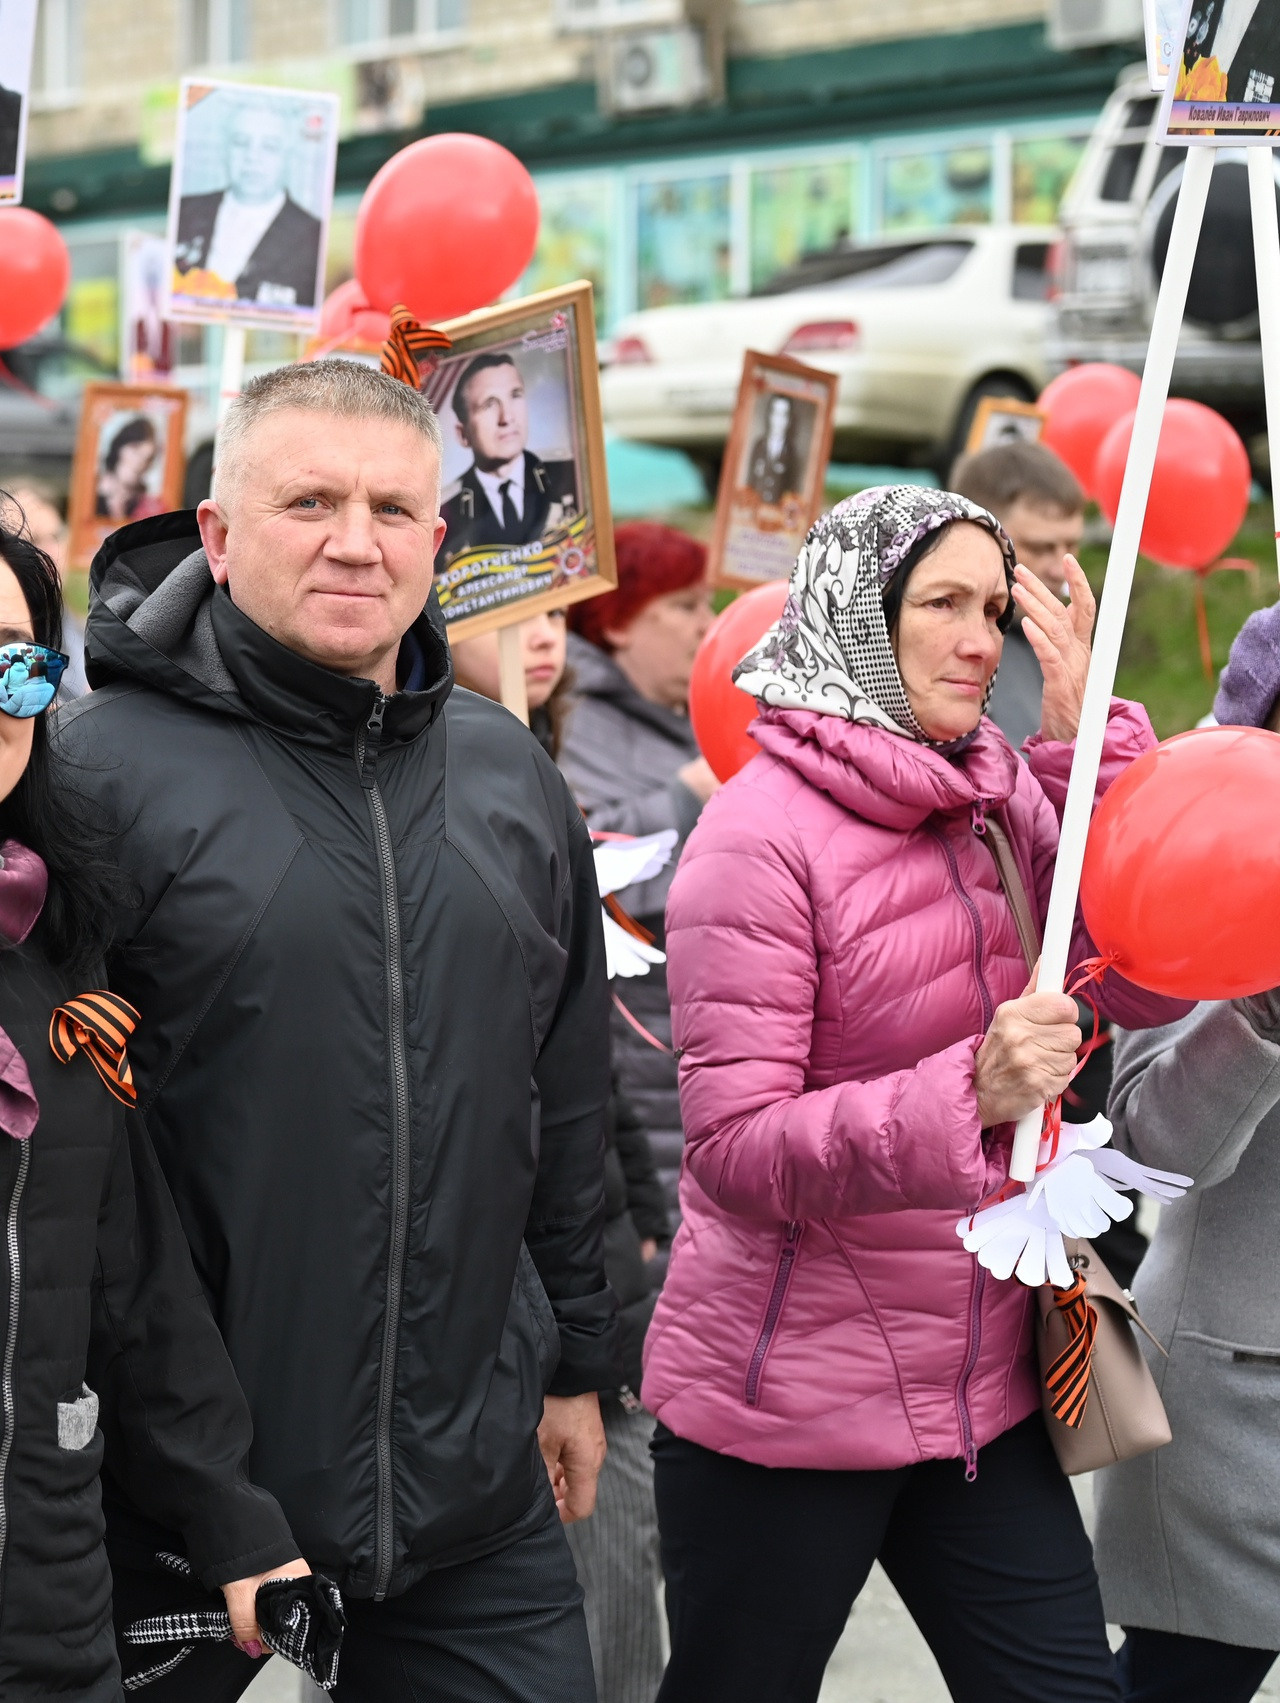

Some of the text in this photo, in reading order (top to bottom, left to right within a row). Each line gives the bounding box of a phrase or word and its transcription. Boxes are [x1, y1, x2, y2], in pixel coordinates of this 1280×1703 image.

[1188, 105, 1271, 126] Ковалёв Иван Гаврилович
[439, 541, 544, 587] КОРОТЧЕНКО
[456, 565, 529, 598] АЛЕКСАНДР
